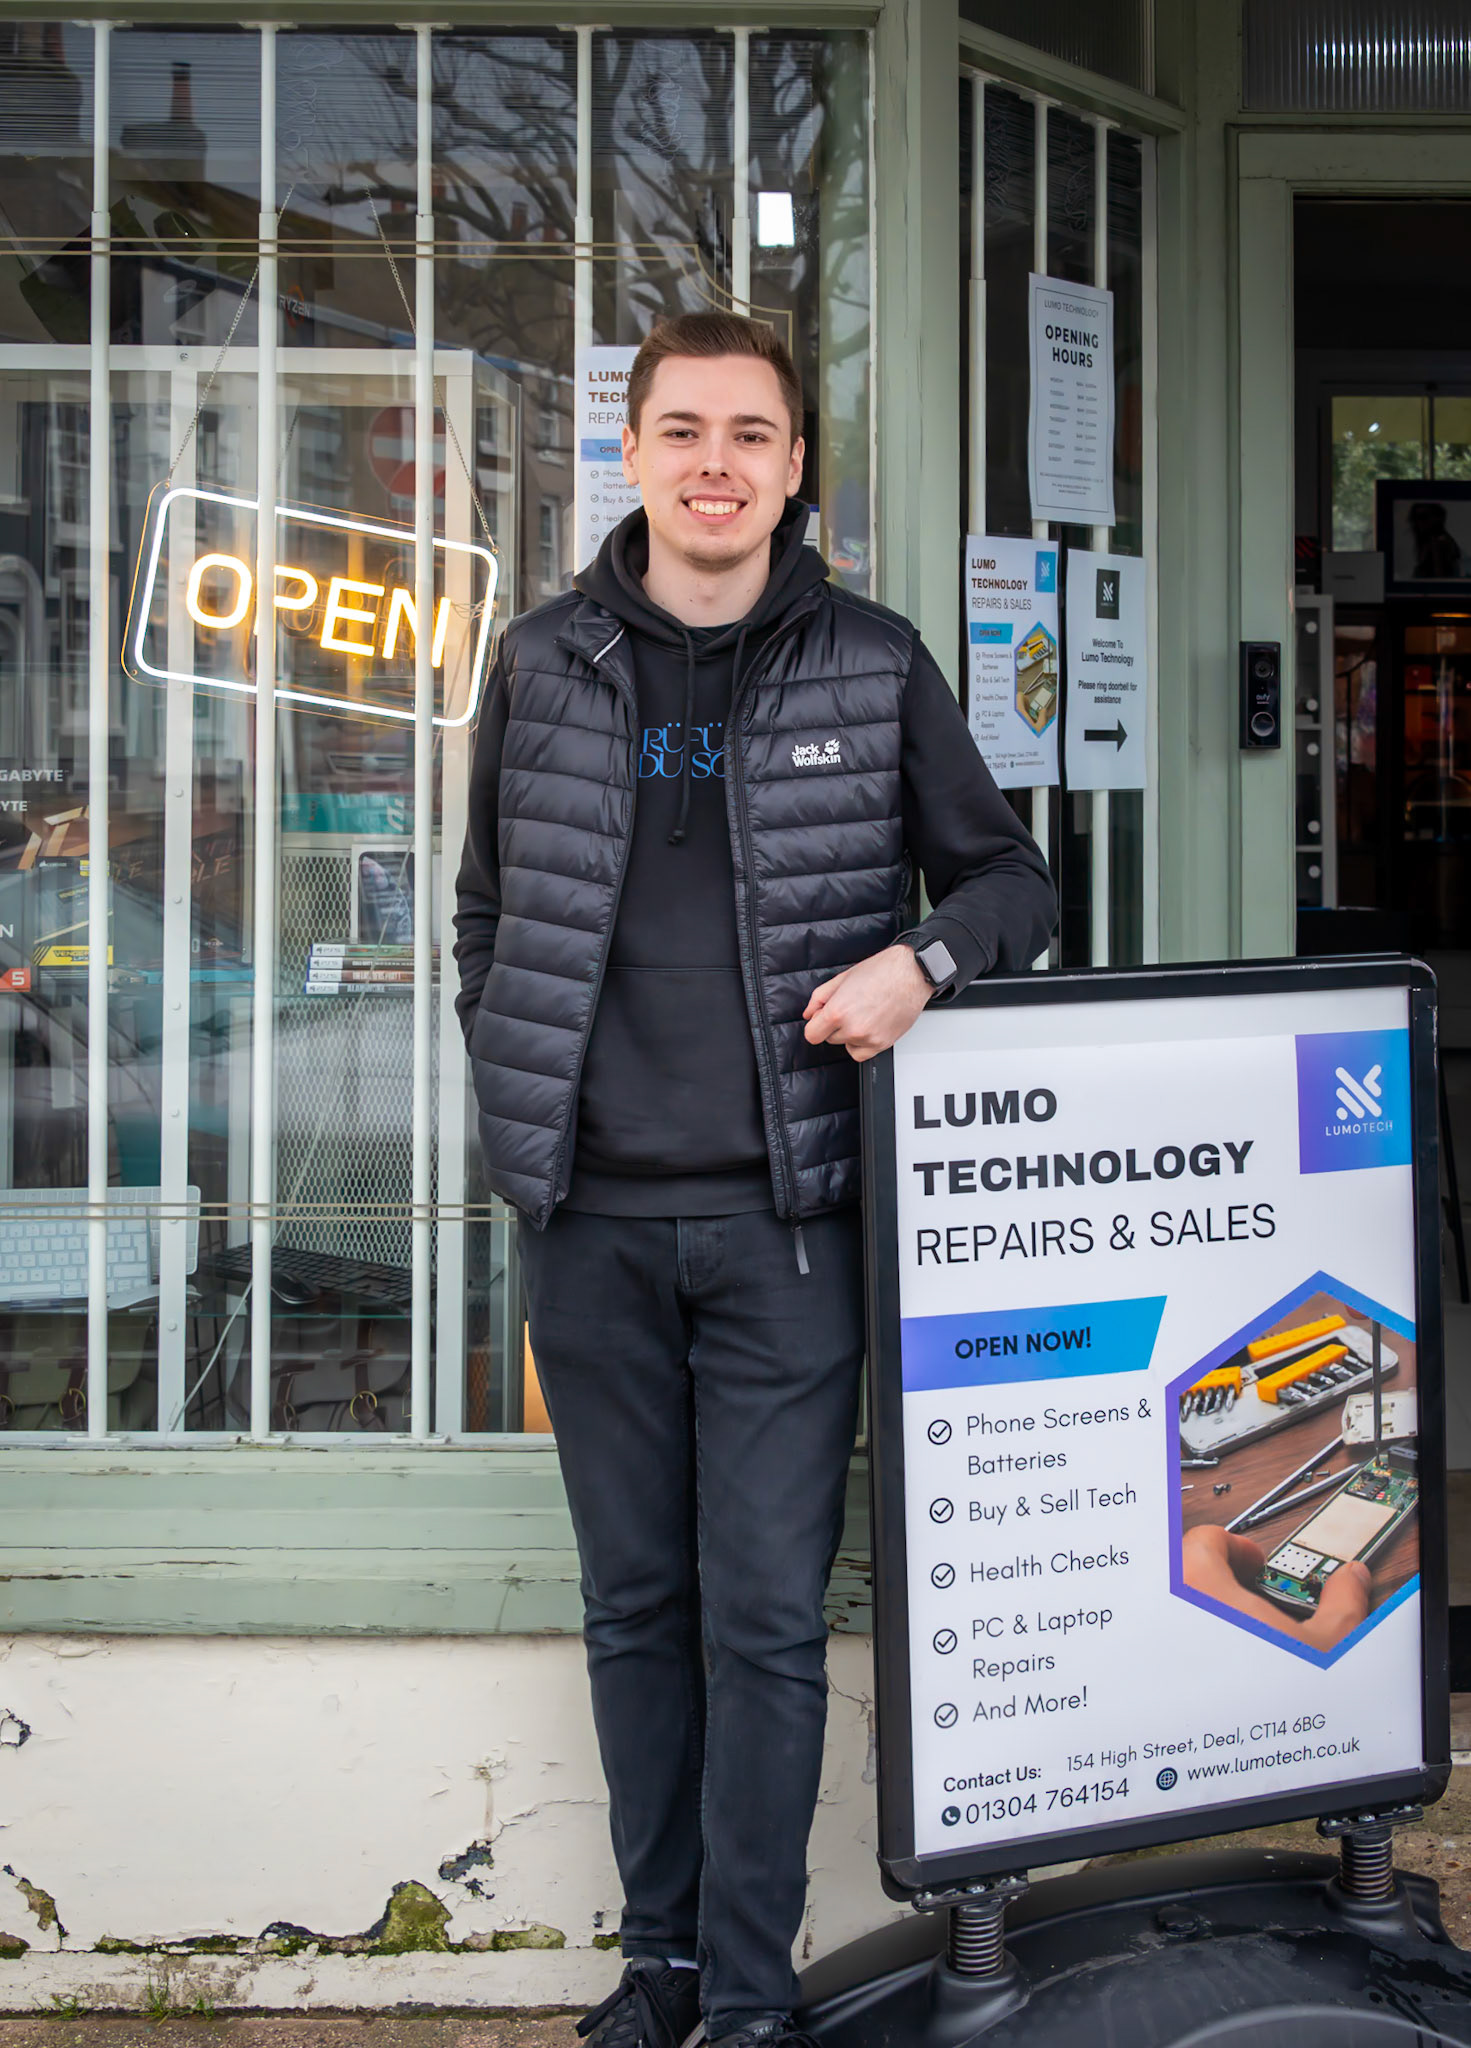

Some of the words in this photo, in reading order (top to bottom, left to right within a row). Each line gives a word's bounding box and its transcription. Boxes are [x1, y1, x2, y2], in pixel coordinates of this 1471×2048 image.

[1044, 299, 1061, 311] LUMO
[1045, 324, 1099, 349] OPENING
[1052, 346, 1093, 368] HOURS
[971, 558, 997, 570] LUMO
[971, 577, 1028, 590] TECHNOLOGY
[186, 553, 451, 668] OPEN
[971, 597, 1002, 610] REPAIRS
[1010, 598, 1032, 611] SALES
[1091, 638, 1116, 649] Welcome
[1116, 639, 1124, 649] To
[1081, 651, 1099, 662] Lumo
[1100, 652, 1134, 667] Technology
[1077, 679, 1096, 690] Please
[1096, 681, 1107, 692] ring
[1108, 681, 1129, 691] doorbell
[1129, 681, 1137, 691] for
[1093, 695, 1122, 704] assistance
[791, 743, 820, 757] Jack
[791, 752, 841, 768] Wolfskin
[914, 1088, 1057, 1129] LUMO
[1325, 1120, 1393, 1137] LUMOTECH
[913, 1140, 1254, 1196] TECHNOLOGY
[916, 1217, 1095, 1266] REPAIRS
[1109, 1214, 1136, 1250] &
[1150, 1203, 1276, 1247] SALES
[955, 1333, 1016, 1359] OPEN
[1026, 1326, 1092, 1353] NOW!
[967, 1413, 1035, 1437] Phone
[1043, 1404, 1130, 1429] Screens
[1137, 1398, 1152, 1418] &
[968, 1450, 1067, 1476] Batteries
[969, 1500, 1008, 1526] Buy
[1015, 1496, 1031, 1517] &
[1041, 1489, 1079, 1514] Sell
[1087, 1483, 1137, 1508] Tech
[971, 1555, 1043, 1583] Health
[1050, 1545, 1130, 1573] Checks
[972, 1617, 1004, 1640] PC
[1013, 1613, 1029, 1635] &
[1038, 1607, 1113, 1636] Laptop
[973, 1653, 1056, 1682] Repairs
[972, 1697, 1016, 1723] And
[1024, 1686, 1088, 1715] More!
[1067, 1753, 1095, 1773] 154
[1100, 1745, 1137, 1769] High
[1143, 1737, 1198, 1761] Street,
[1203, 1727, 1245, 1751] Deal,
[1250, 1721, 1288, 1742] CT14
[1293, 1713, 1326, 1734] 6BG
[1188, 1738, 1361, 1781] www.lumotech.co.uk
[943, 1769, 1012, 1793] Contact
[1016, 1765, 1042, 1783] Us:
[966, 1794, 1038, 1824] 01304
[1046, 1778, 1130, 1810] 764154
